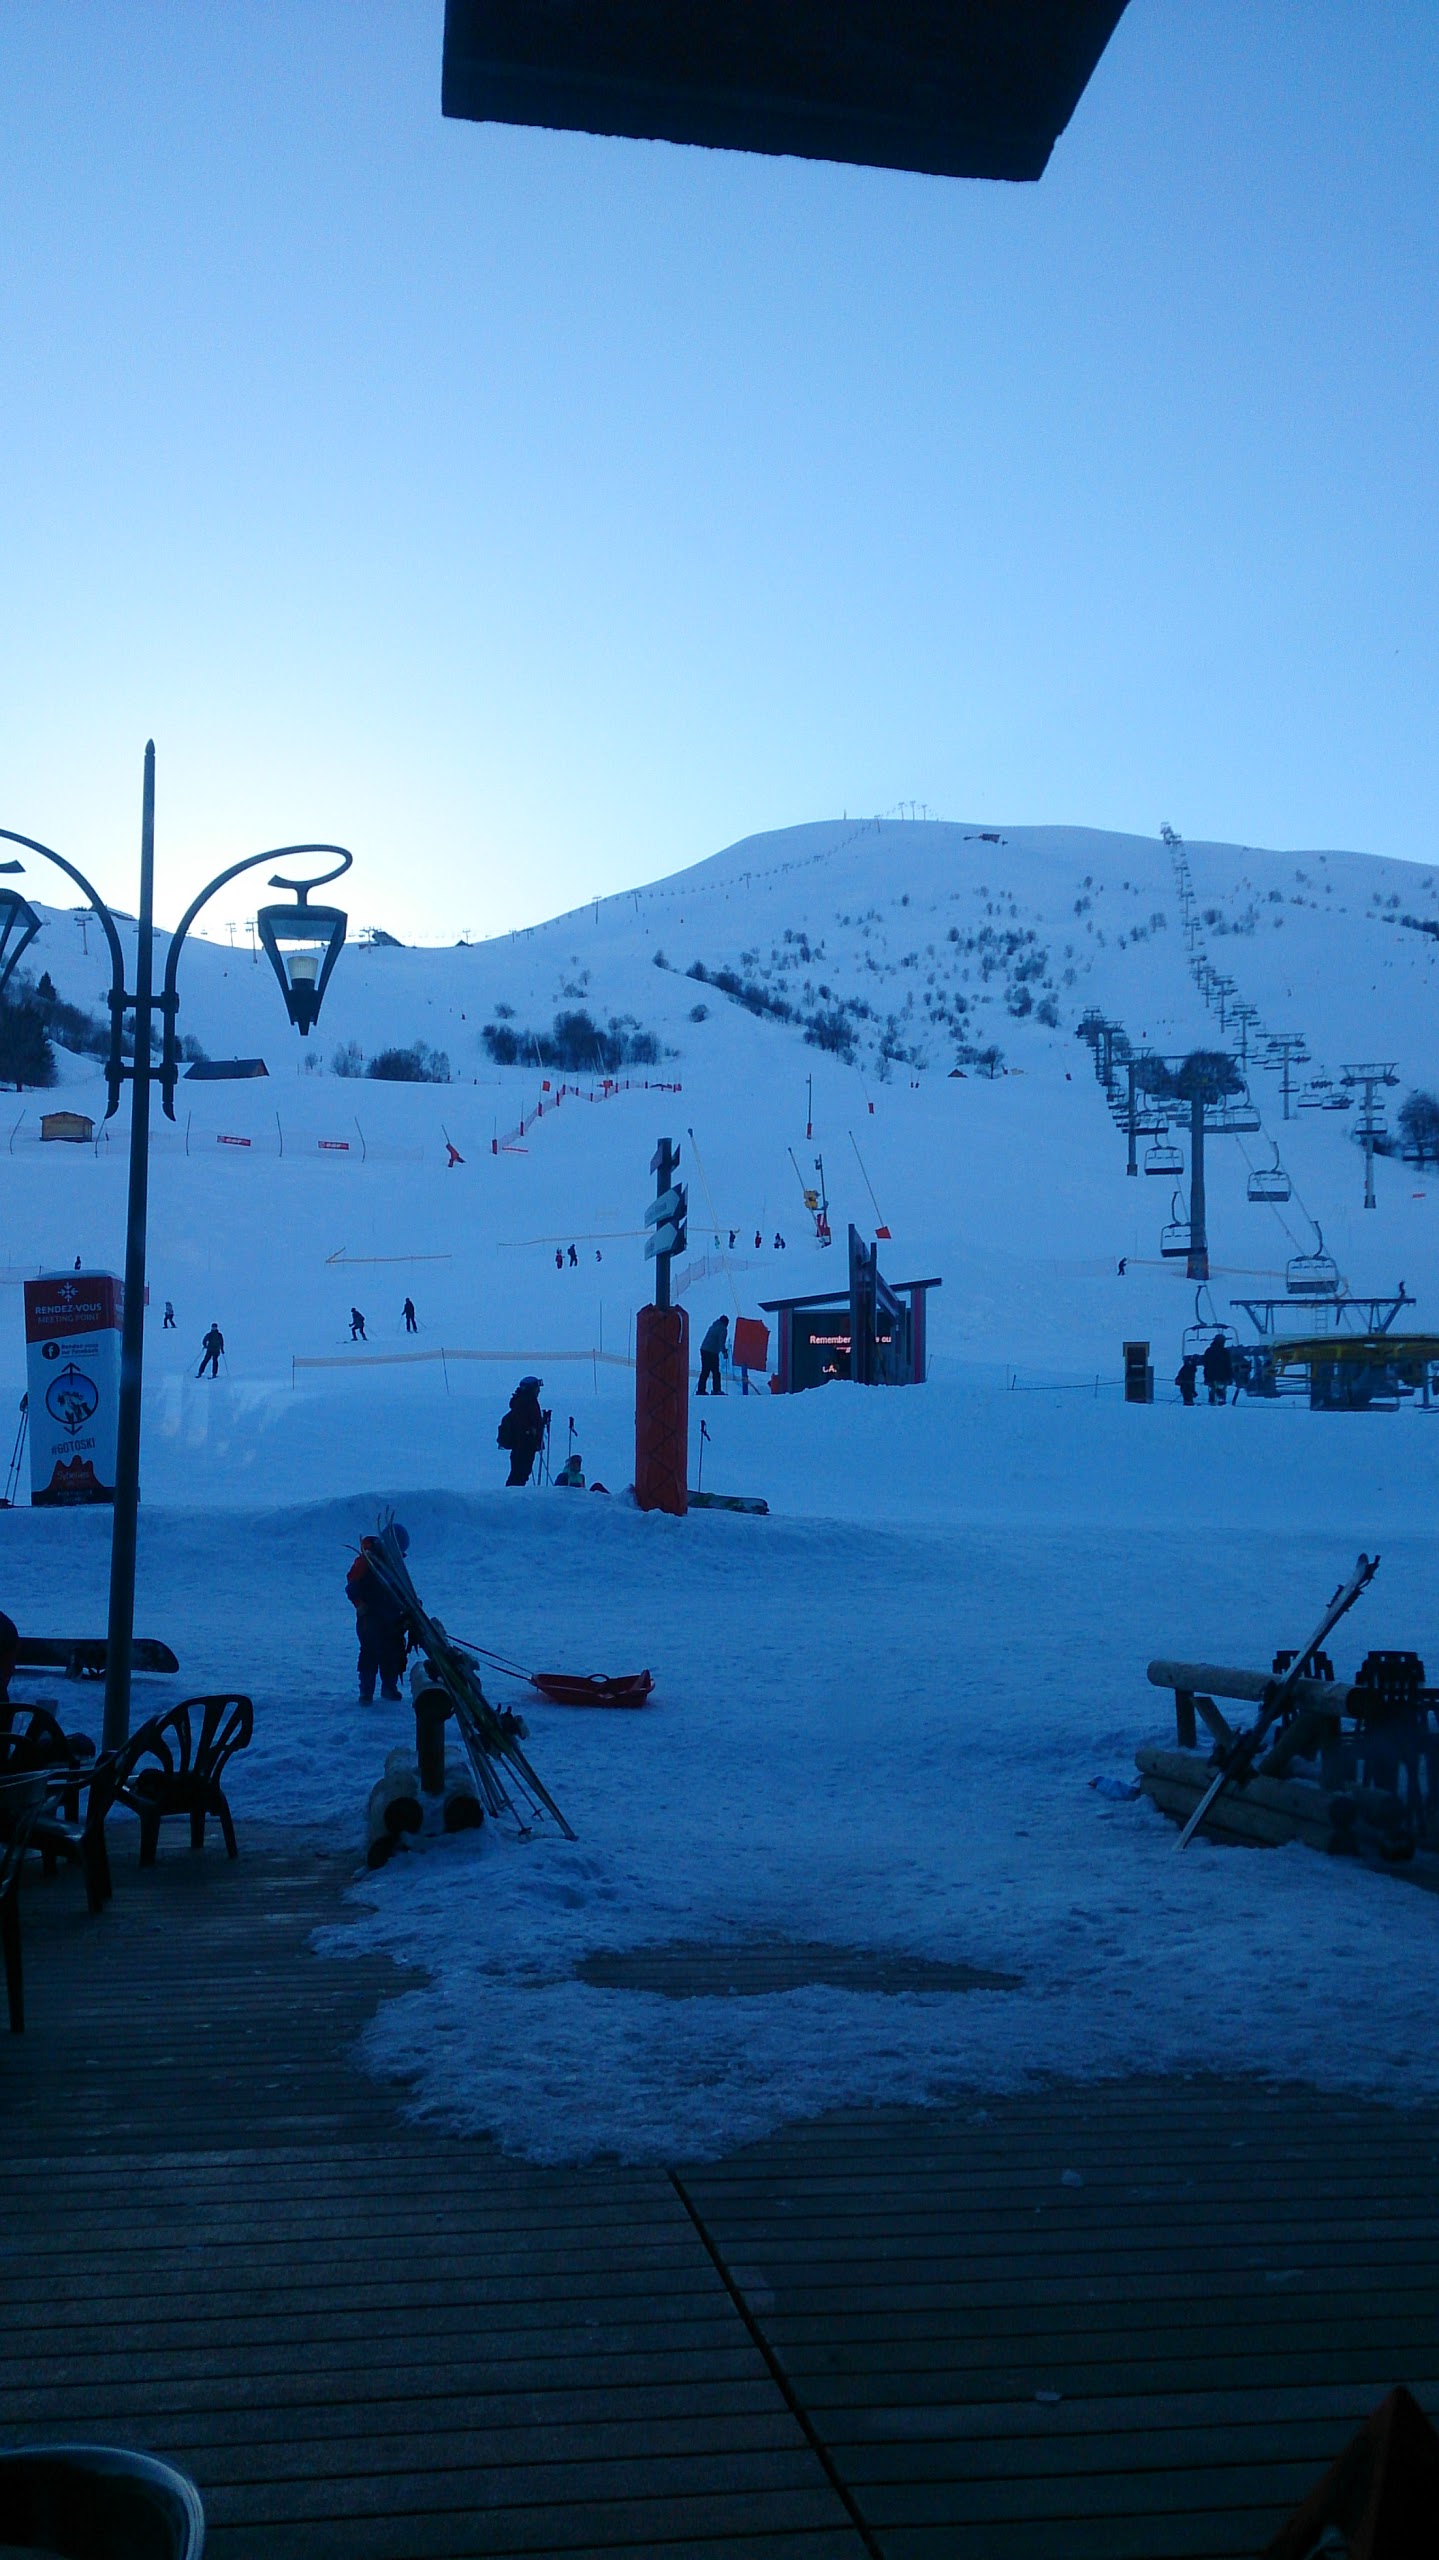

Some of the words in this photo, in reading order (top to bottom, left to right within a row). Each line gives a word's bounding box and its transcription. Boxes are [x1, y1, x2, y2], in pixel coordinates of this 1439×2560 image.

[35, 1303, 102, 1315] RENDEZ-VOUS
[809, 1334, 851, 1344] Remember
[51, 1437, 96, 1455] #GOTOSKI
